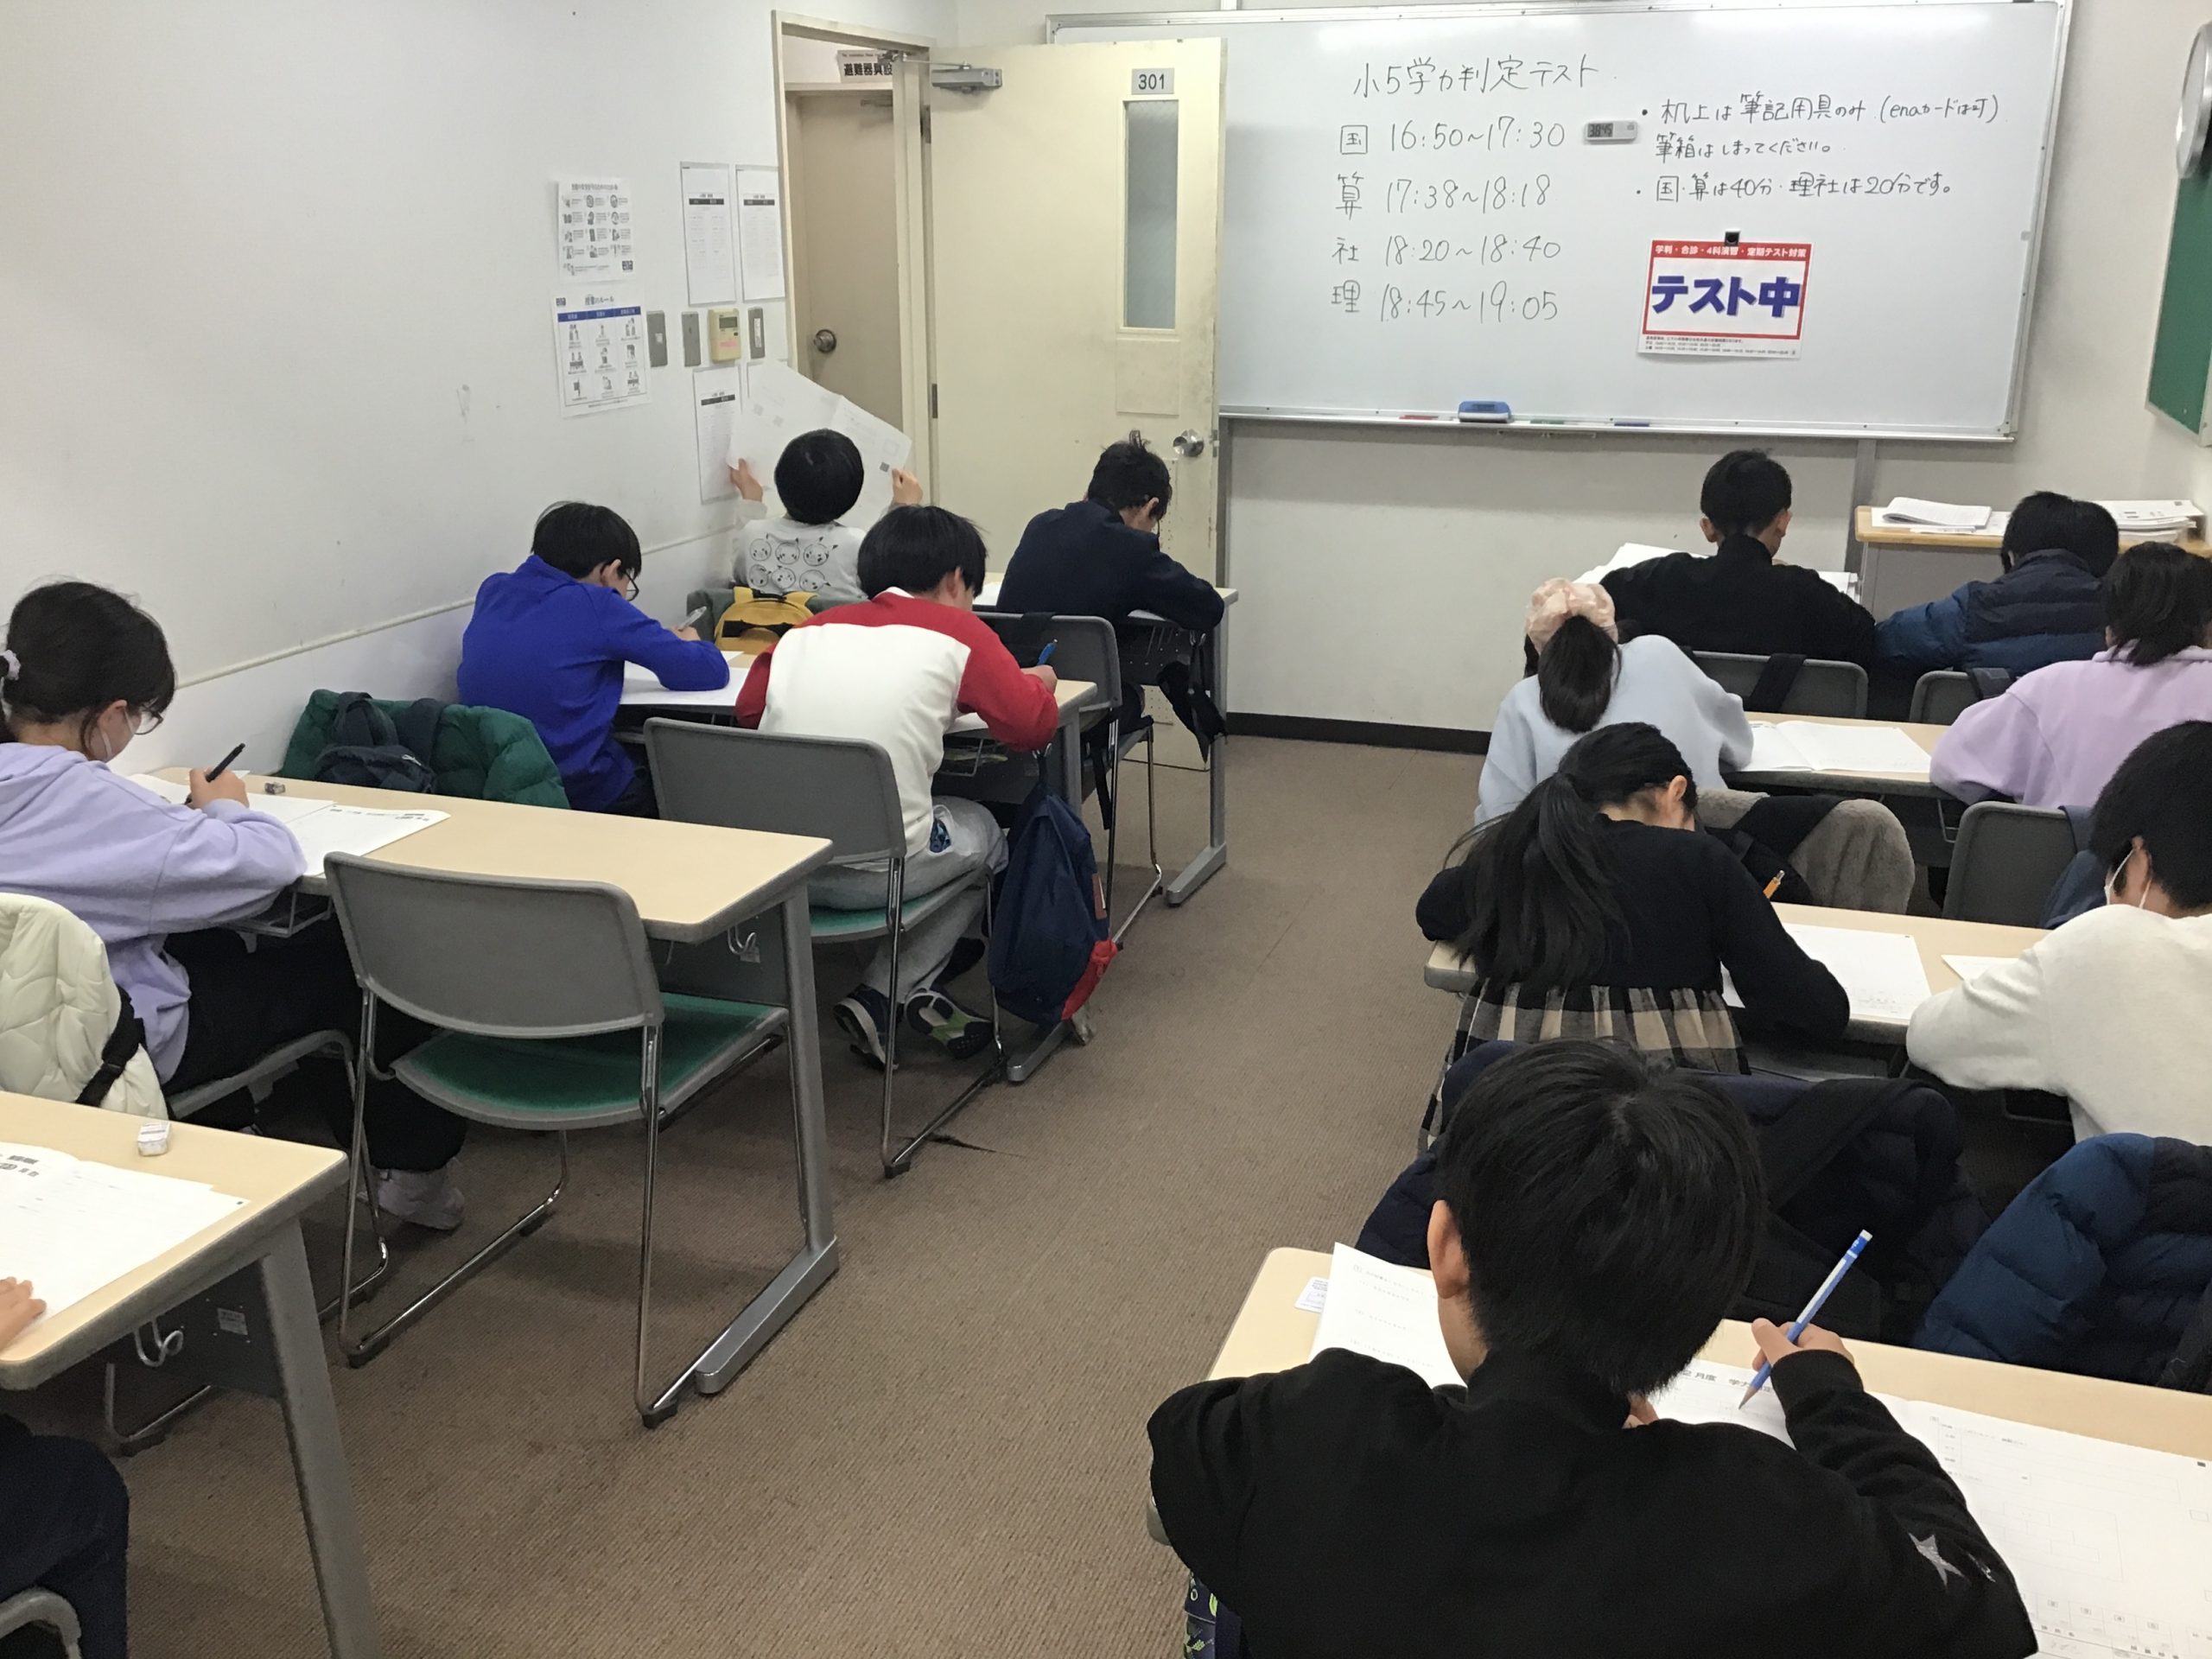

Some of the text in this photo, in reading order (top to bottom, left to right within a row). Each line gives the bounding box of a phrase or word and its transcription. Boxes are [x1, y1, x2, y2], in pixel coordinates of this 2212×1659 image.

[1138, 73, 1165, 90] 301
[1335, 171, 1364, 220] 算
[1332, 237, 1360, 264] 社
[1332, 280, 1361, 314] 理
[1651, 275, 1802, 319] テスト中
